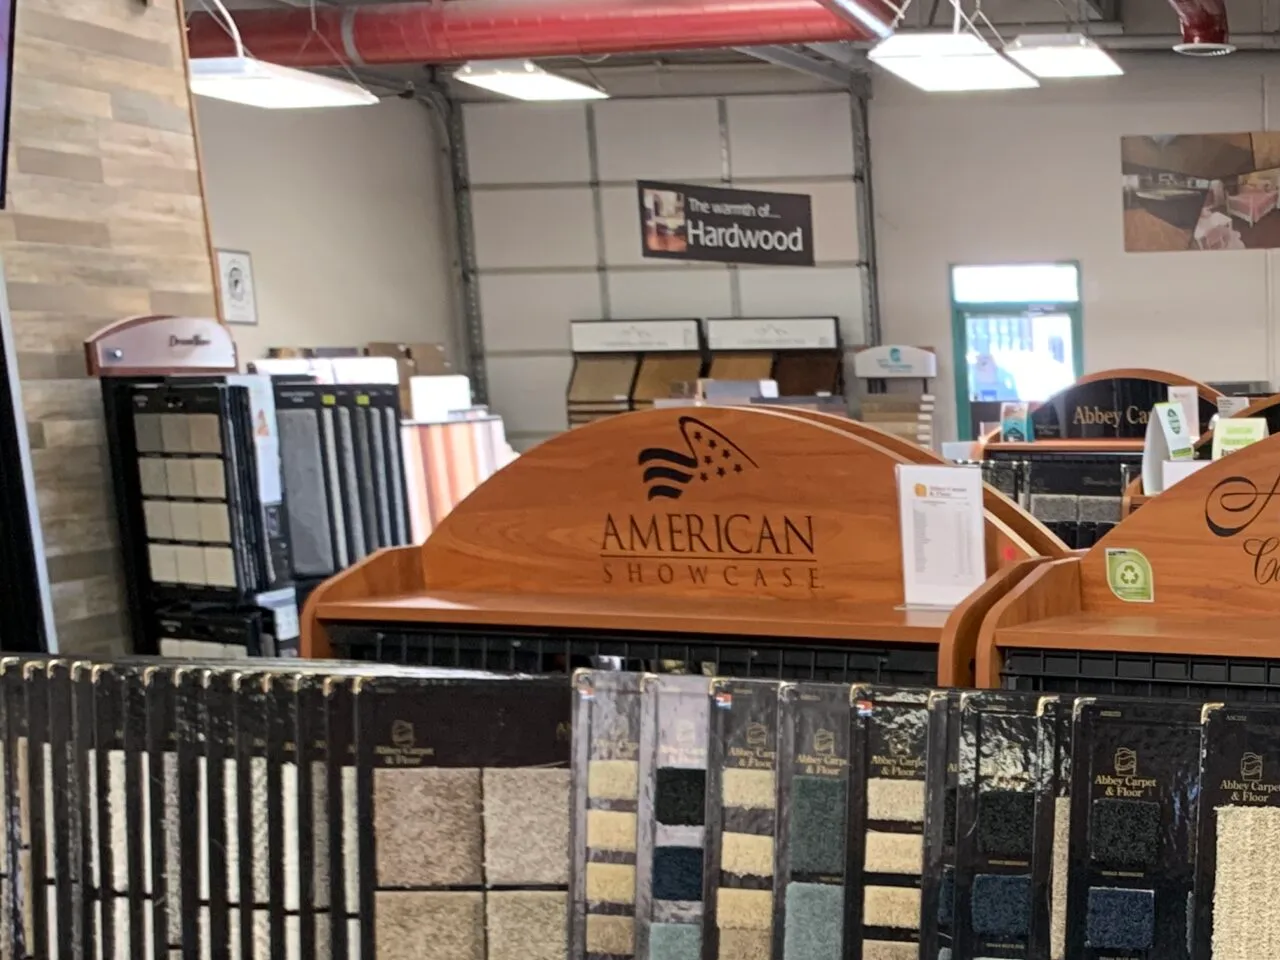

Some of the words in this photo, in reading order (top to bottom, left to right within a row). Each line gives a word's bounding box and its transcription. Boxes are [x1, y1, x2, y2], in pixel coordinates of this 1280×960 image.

[687, 197, 710, 214] The
[712, 202, 756, 217] warmth
[687, 219, 803, 252] Hardwood
[1072, 405, 1122, 428] Abbey
[601, 512, 816, 555] AMERICAN
[602, 563, 819, 589] SHOWCASE
[1095, 774, 1123, 786] Abbey
[1125, 776, 1156, 788] Carpet
[1221, 779, 1249, 791] Abbey
[1105, 786, 1114, 796] &
[1117, 786, 1144, 797] Floor
[1231, 791, 1239, 801] &
[1243, 791, 1269, 802] Floor
